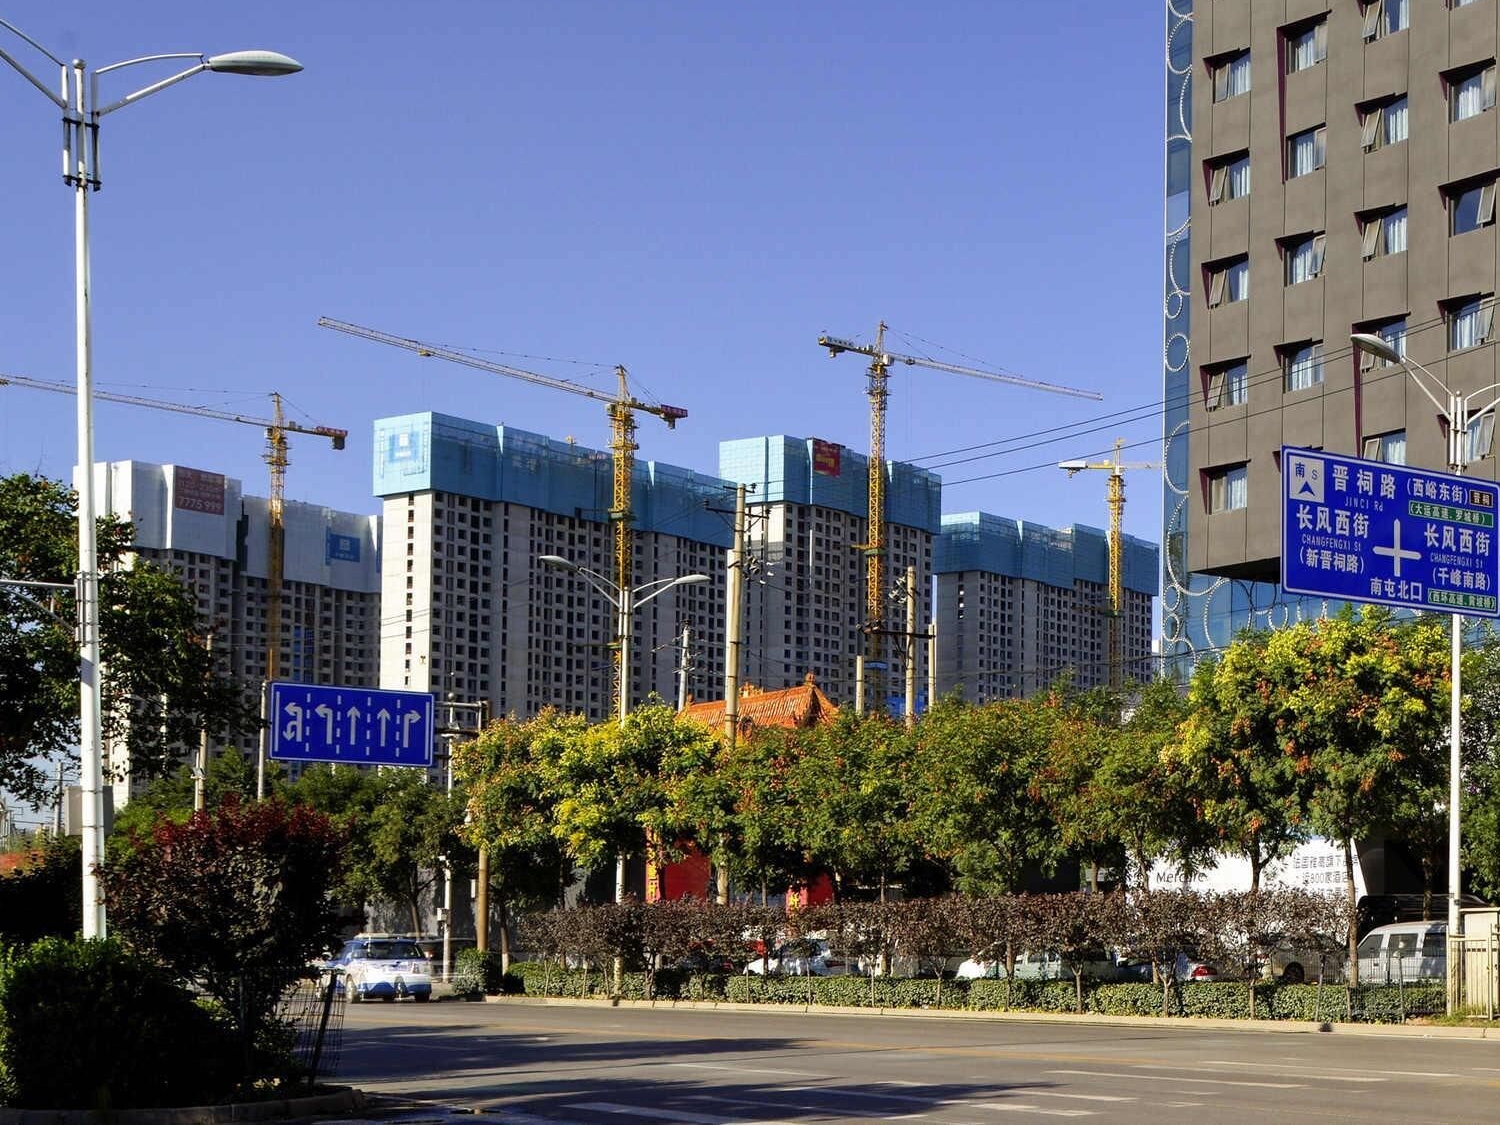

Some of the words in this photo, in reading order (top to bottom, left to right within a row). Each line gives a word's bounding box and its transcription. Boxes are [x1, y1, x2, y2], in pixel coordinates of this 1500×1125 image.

[1295, 462, 1305, 479] 南
[1312, 468, 1319, 481] S
[1332, 464, 1396, 500] 晋祠路
[1344, 496, 1369, 510] JINCI
[1374, 500, 1384, 513] Rd
[1296, 503, 1369, 539] 长风西街
[1302, 533, 1351, 551] CHANGFENGXI
[1424, 522, 1490, 557] 长风西街
[1370, 577, 1422, 601] 南屯北口
